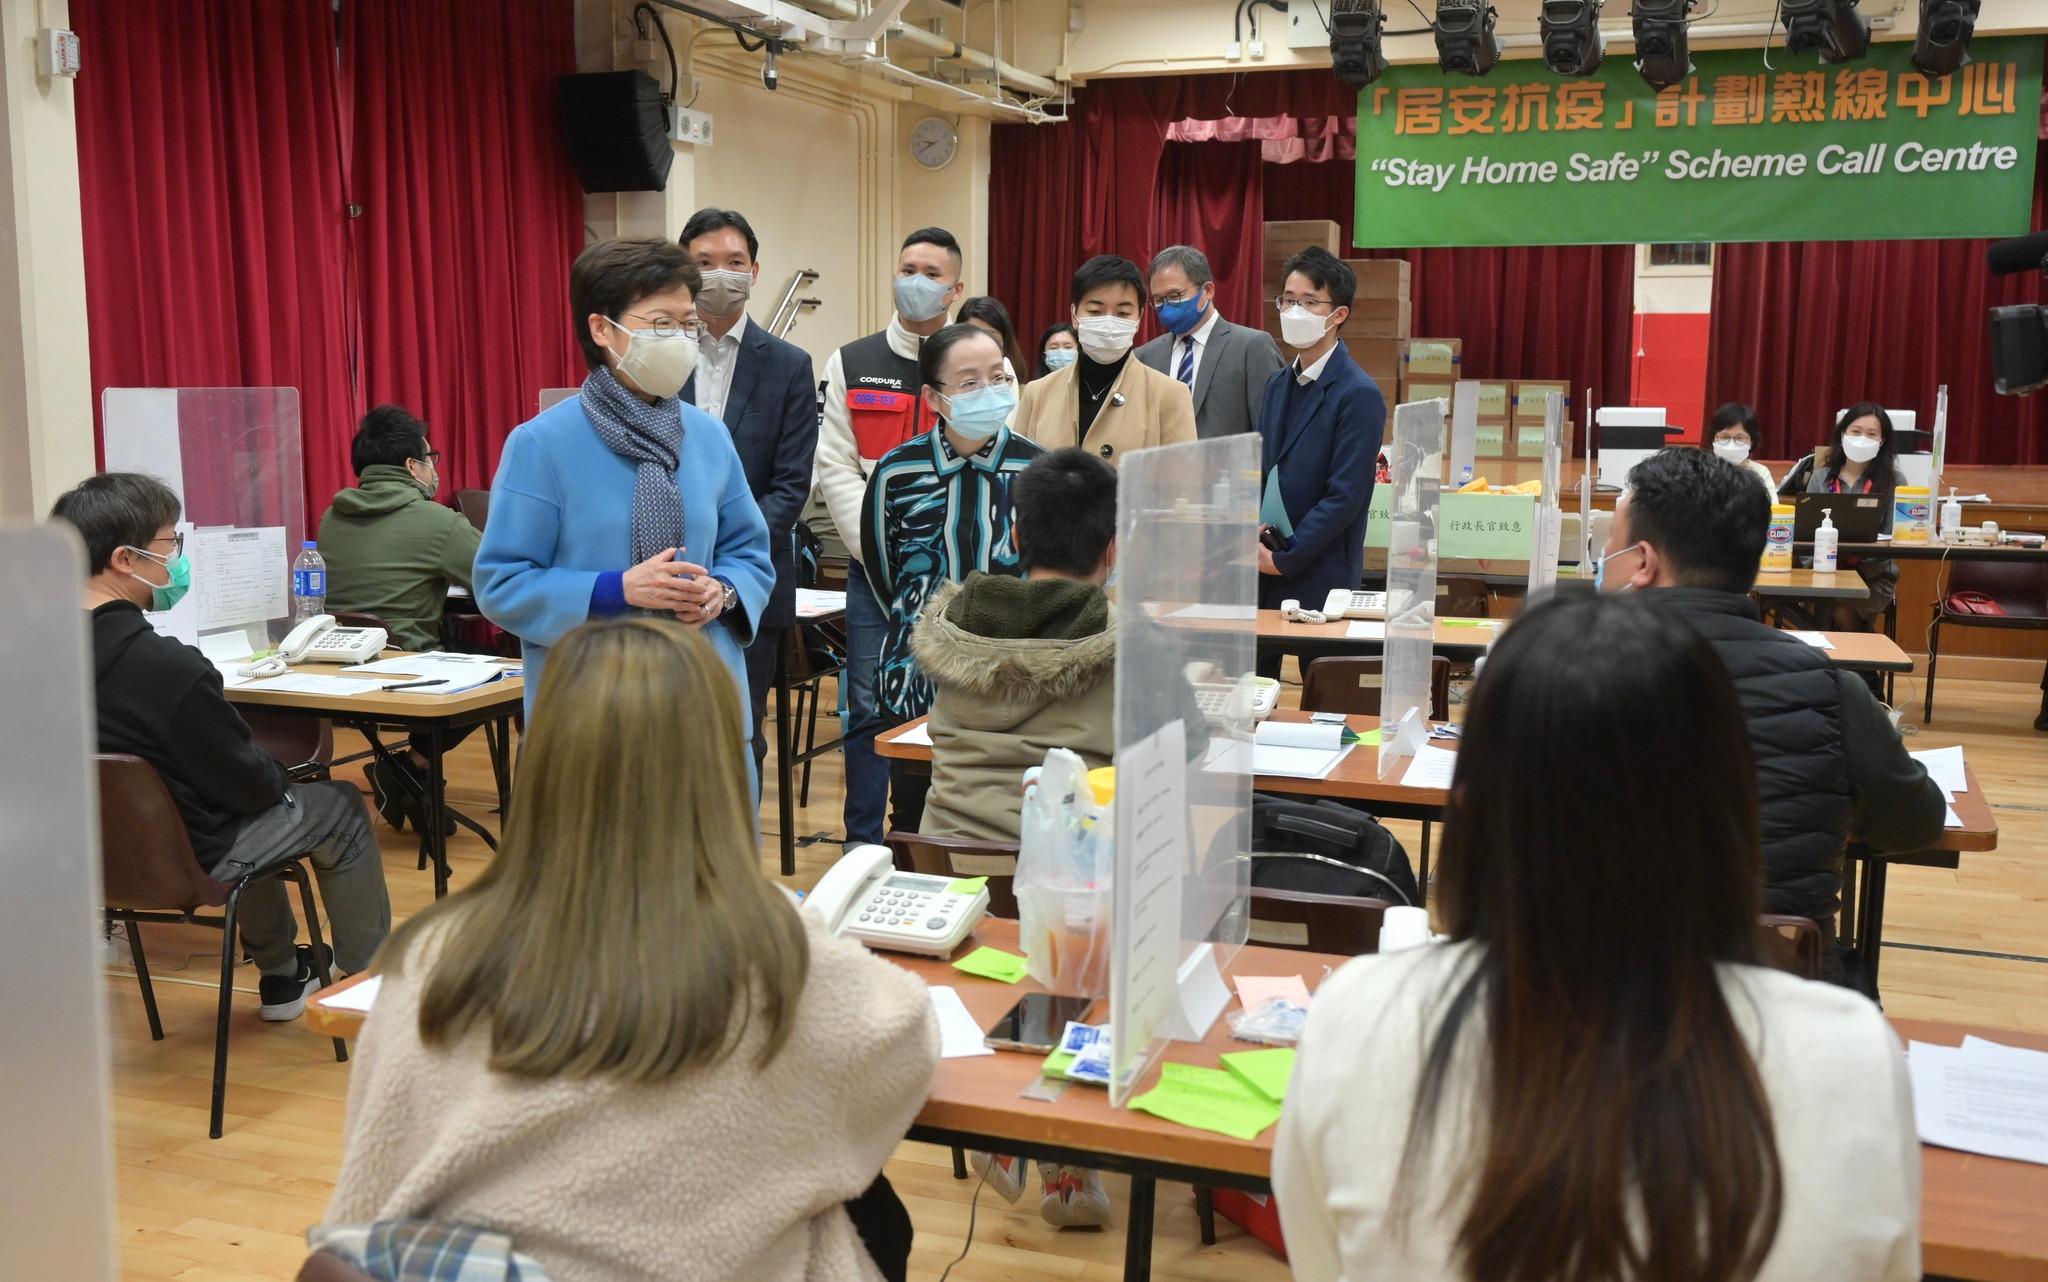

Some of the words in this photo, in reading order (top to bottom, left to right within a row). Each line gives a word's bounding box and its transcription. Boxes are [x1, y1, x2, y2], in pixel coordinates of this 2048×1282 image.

[1373, 63, 2017, 135] 「居安抗疫」計劃熱線中心
[1371, 157, 1456, 192] “Stay
[1460, 155, 1557, 185] Home
[1565, 151, 1660, 182] Safe”
[1665, 149, 1807, 180] Scheme
[1817, 143, 1887, 175] Call
[1894, 141, 2017, 173] Centre
[1449, 519, 1522, 533] 行政長官致意
